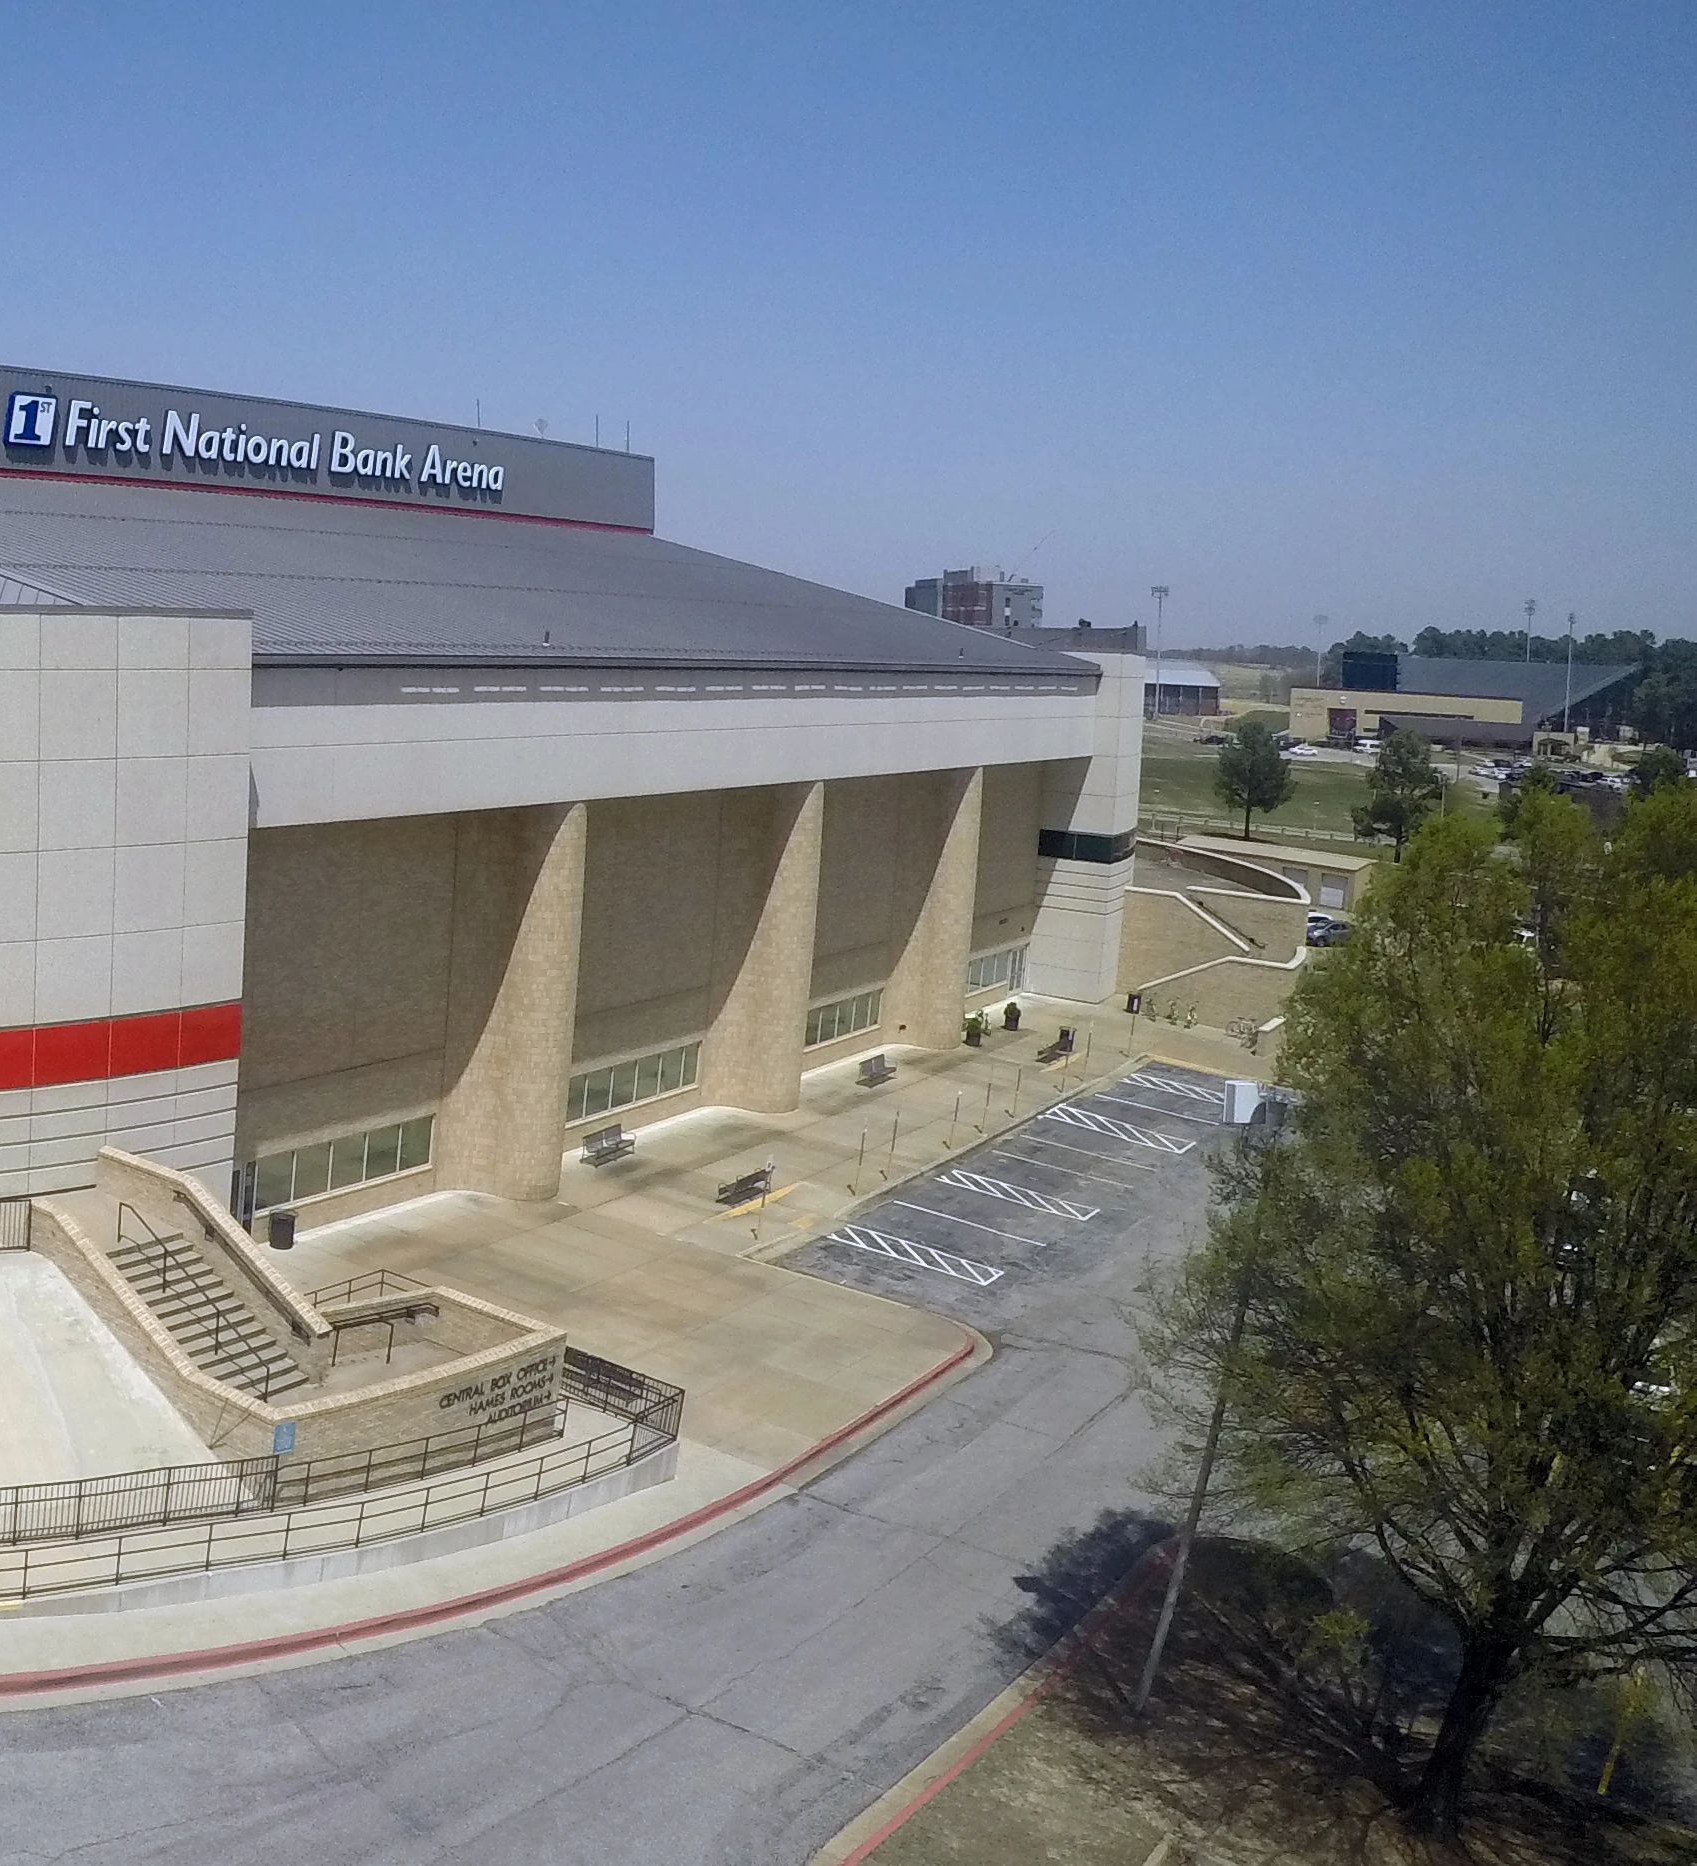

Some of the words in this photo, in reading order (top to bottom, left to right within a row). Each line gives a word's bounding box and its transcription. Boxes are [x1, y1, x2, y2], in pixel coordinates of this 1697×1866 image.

[14, 399, 53, 442] 1ST
[64, 399, 151, 453] First
[162, 410, 321, 470] National
[330, 430, 412, 480] Bank
[419, 444, 505, 491] Arena
[439, 1382, 485, 1409] CENTRAL
[490, 1371, 512, 1392] BOX
[516, 1359, 549, 1381] OFFICE
[509, 1375, 546, 1400] ROOMS
